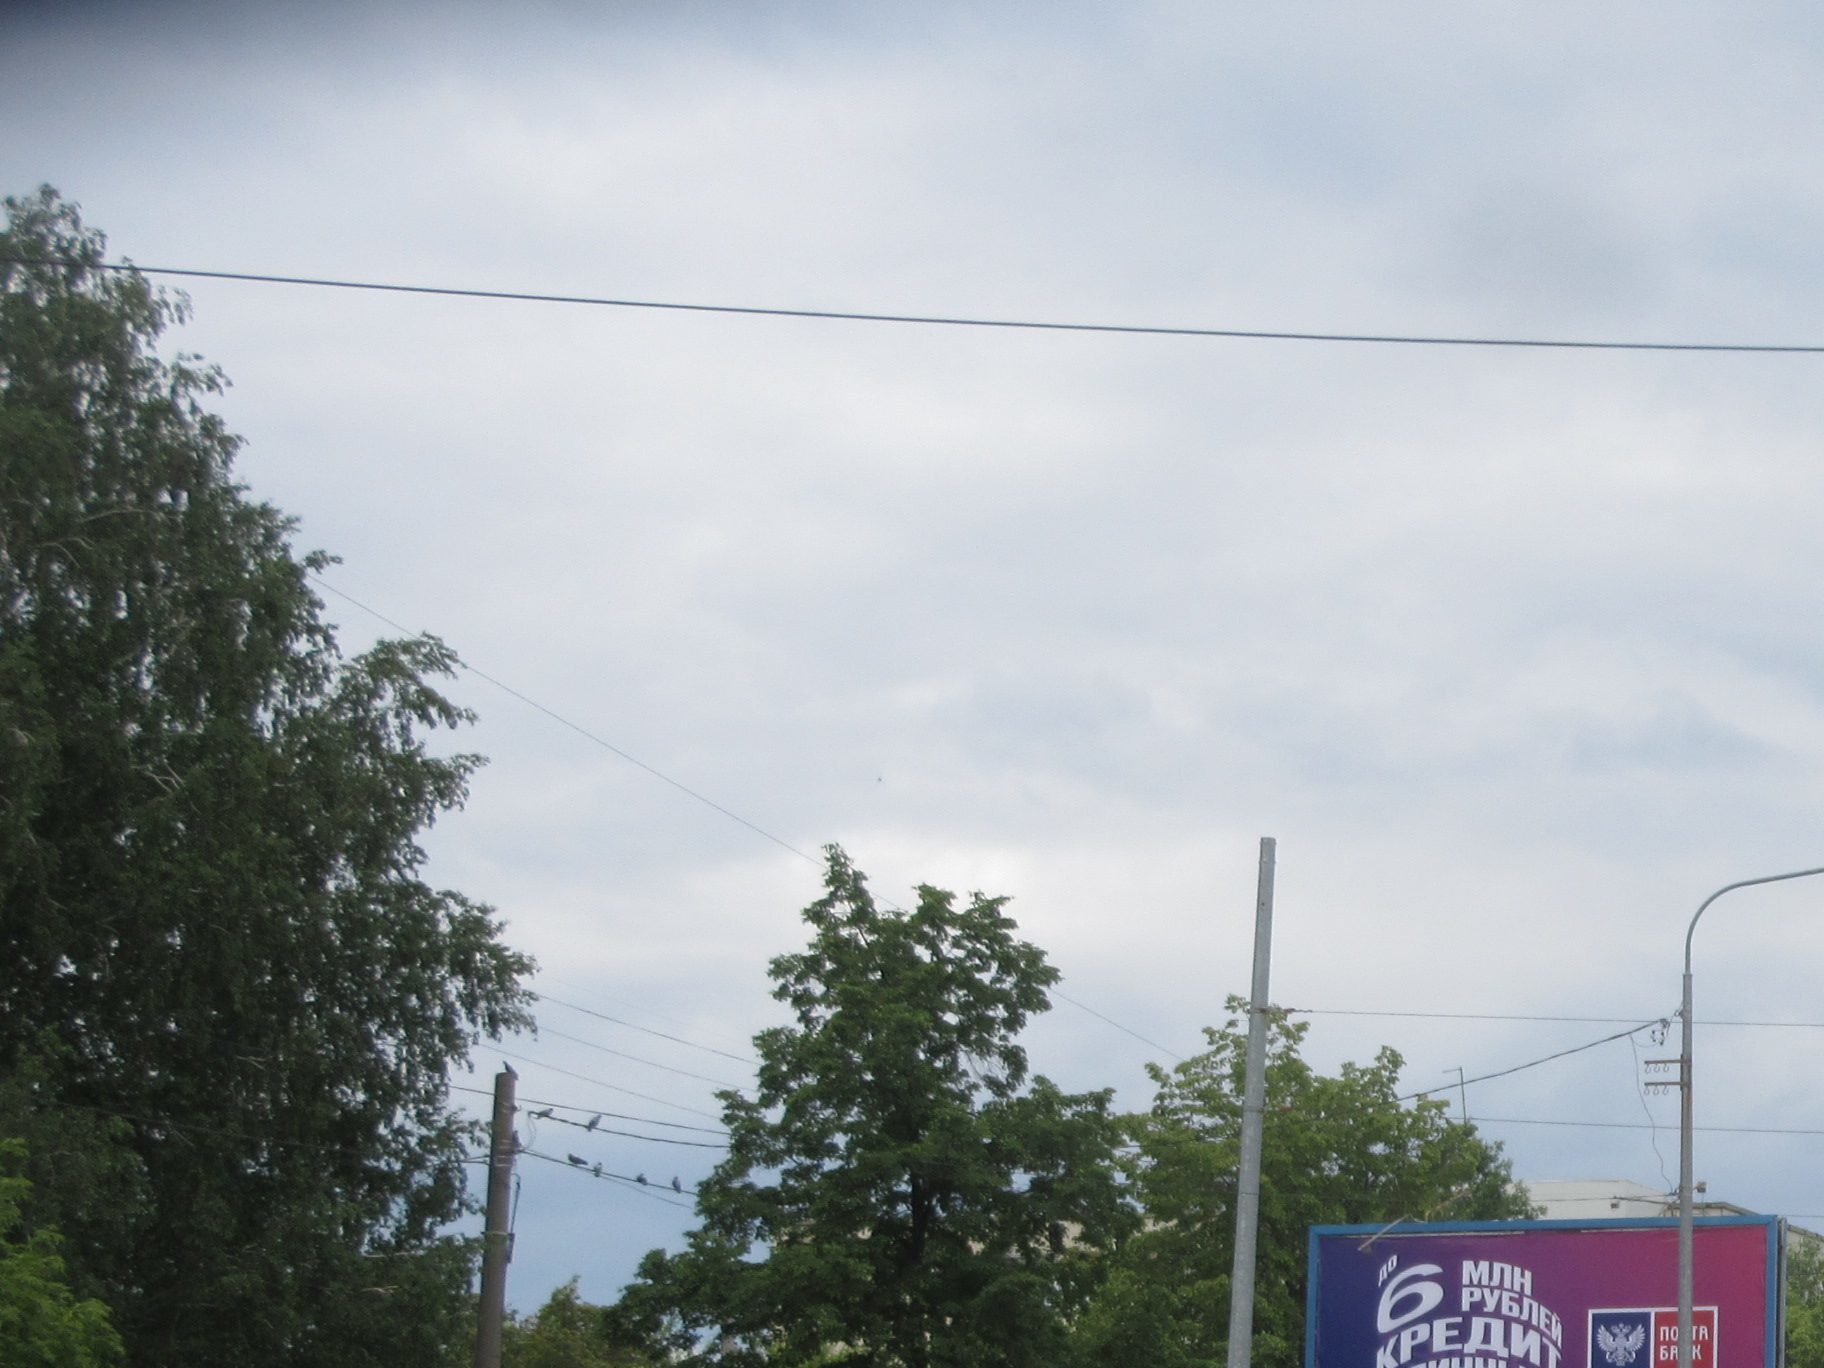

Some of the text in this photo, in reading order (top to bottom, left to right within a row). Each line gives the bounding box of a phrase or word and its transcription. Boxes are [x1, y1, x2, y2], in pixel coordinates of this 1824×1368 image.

[1378, 1254, 1398, 1288] ДО
[1462, 1260, 1532, 1296] МЛН
[1376, 1263, 1444, 1334] 6
[1461, 1287, 1562, 1350] РУБЛЕЙ
[1660, 1325, 1708, 1341] ПОТА
[1660, 1344, 1701, 1361] БАК
